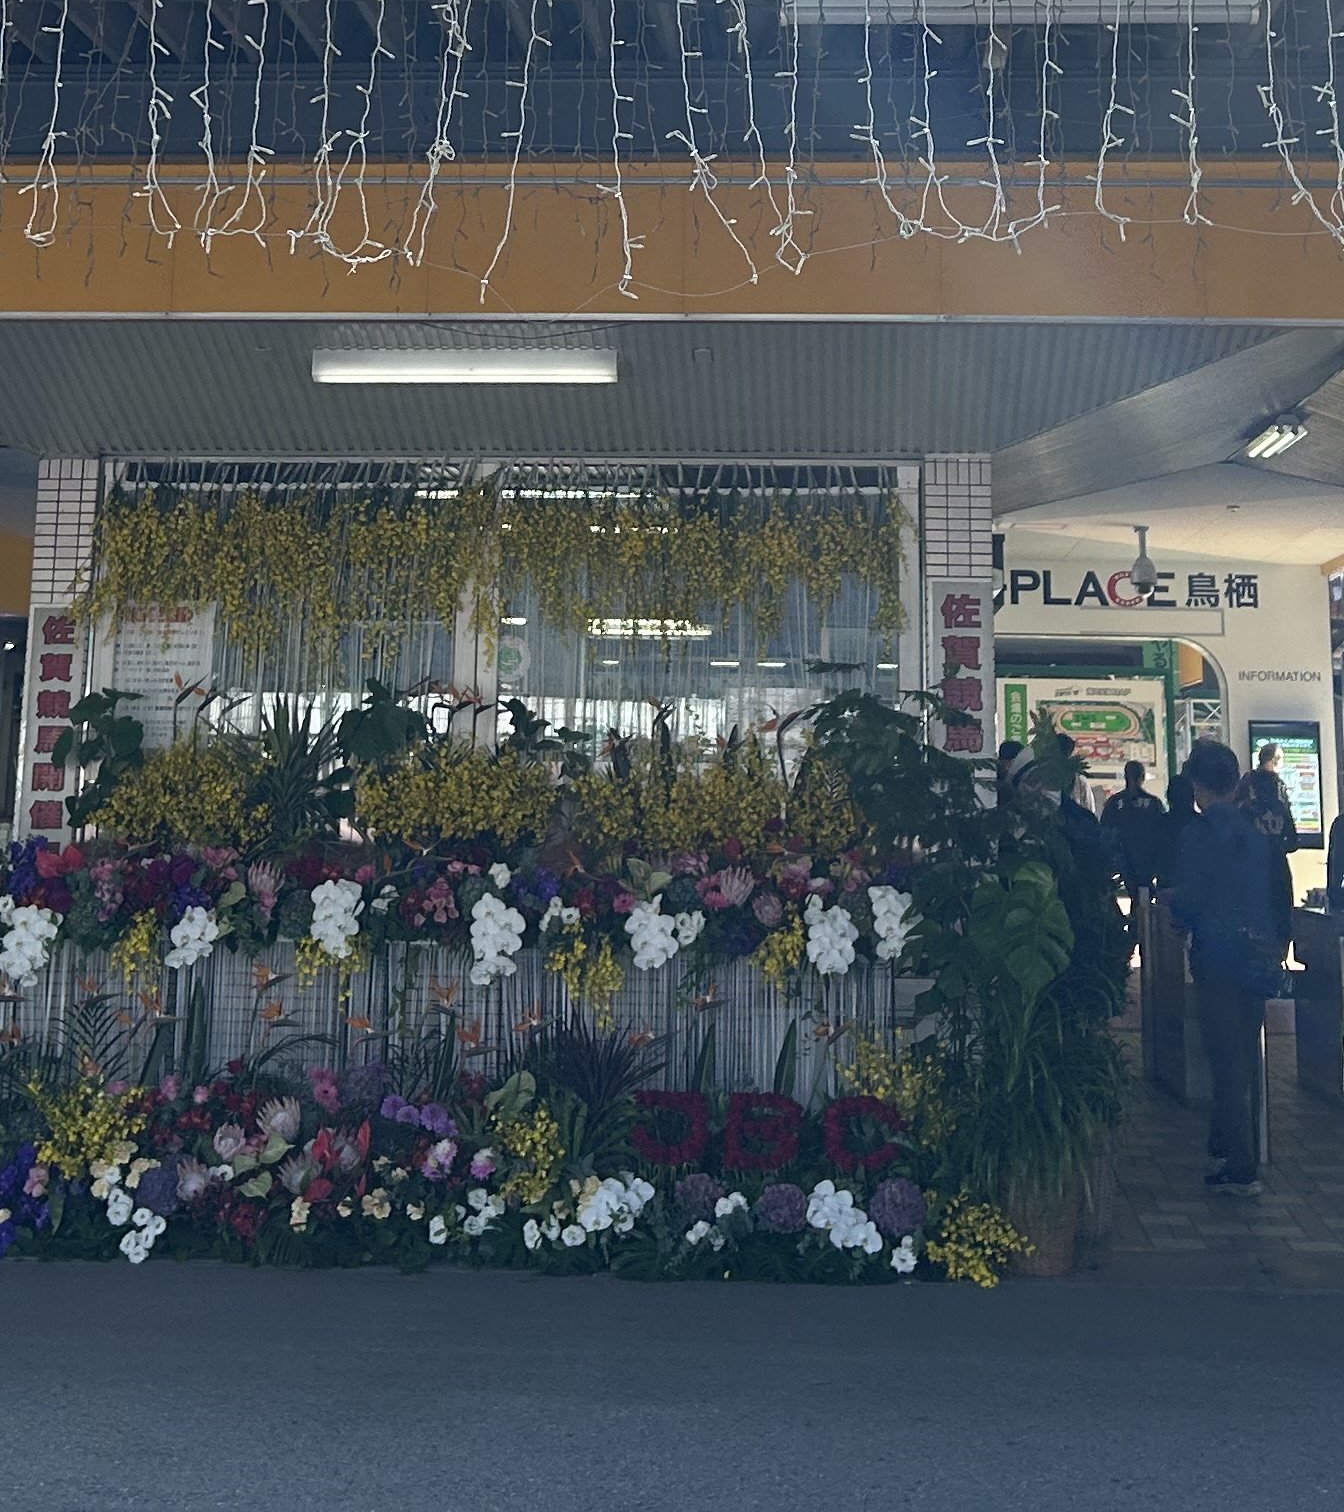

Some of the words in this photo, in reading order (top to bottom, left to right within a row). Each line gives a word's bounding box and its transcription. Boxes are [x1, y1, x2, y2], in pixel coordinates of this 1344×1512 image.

[1185, 572, 1259, 609] 鳥栖
[1238, 670, 1321, 682] INFORMATION
[29, 615, 77, 851] 佐賀競馬開催
